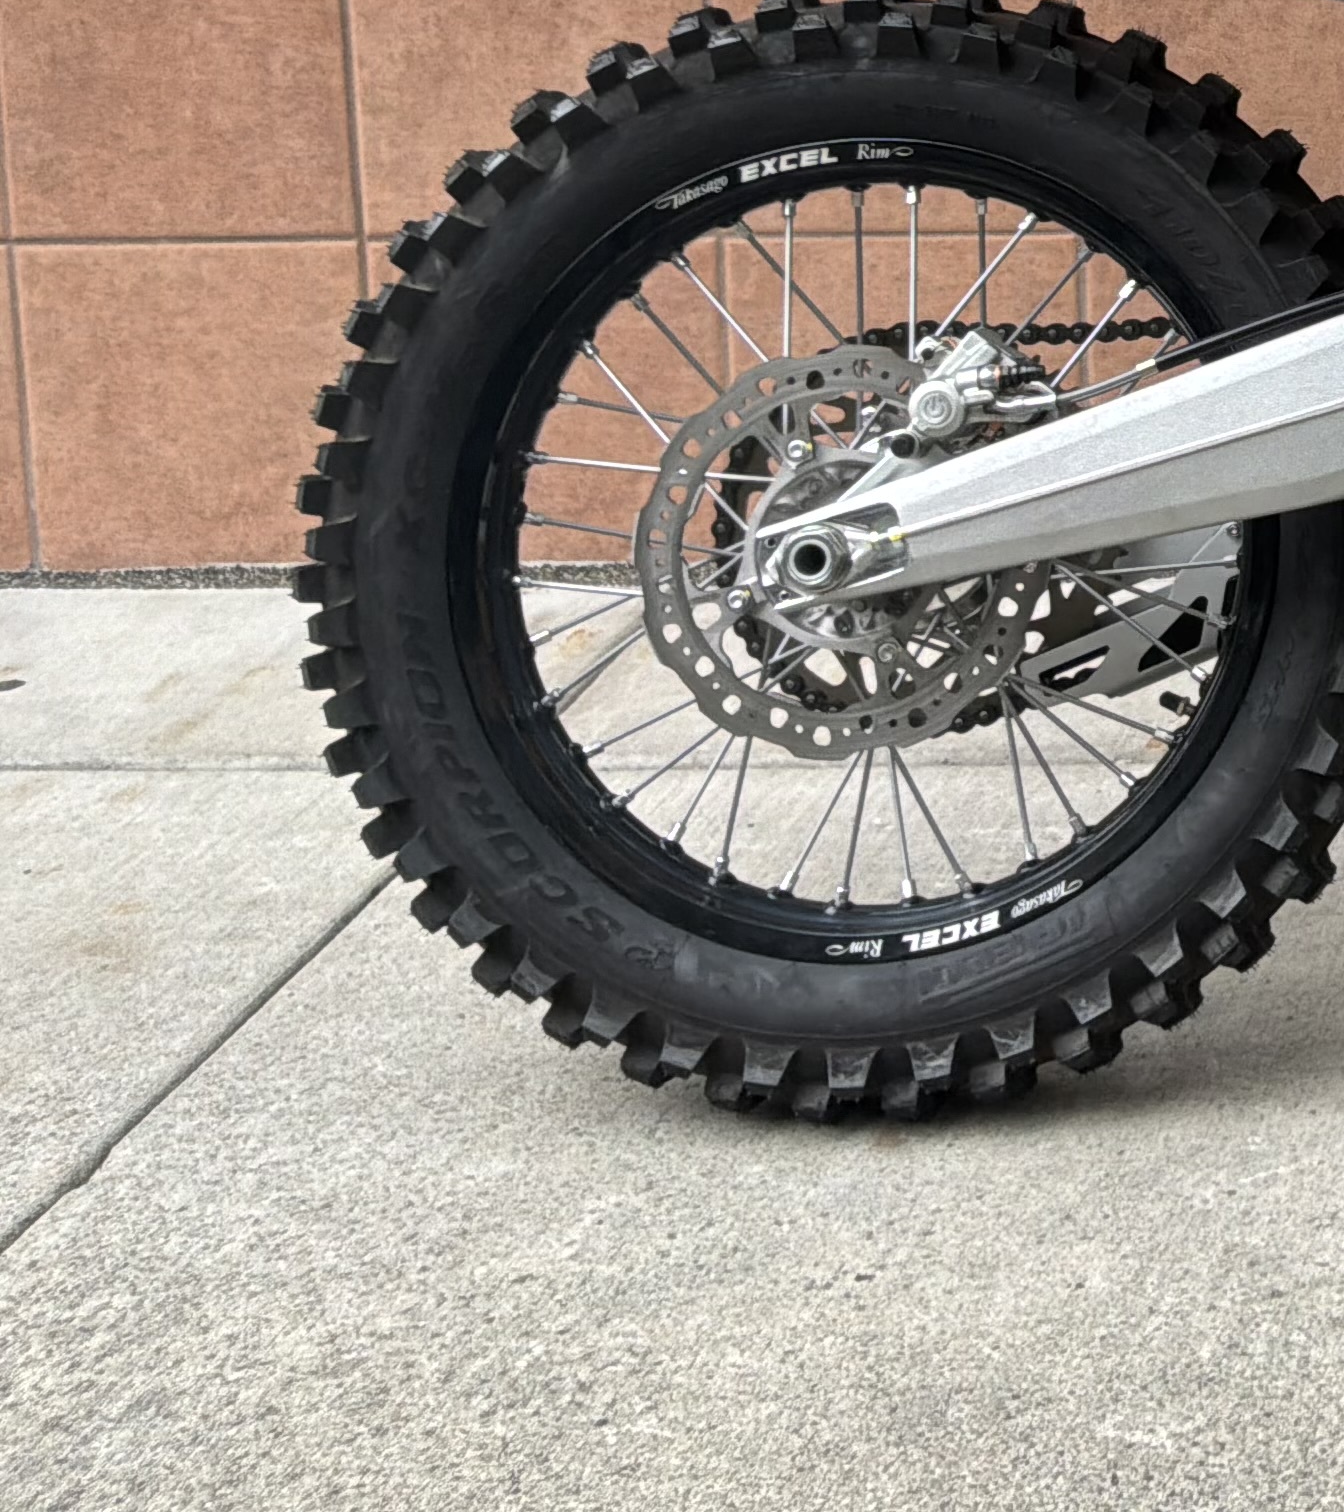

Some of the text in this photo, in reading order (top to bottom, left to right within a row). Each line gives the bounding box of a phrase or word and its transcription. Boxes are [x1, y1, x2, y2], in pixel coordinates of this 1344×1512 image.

[654, 143, 914, 210] Takasago EXCEL Rim
[1010, 878, 1084, 919] Takasago
[824, 938, 885, 959] Rim
[901, 909, 1001, 953] EXCEL
